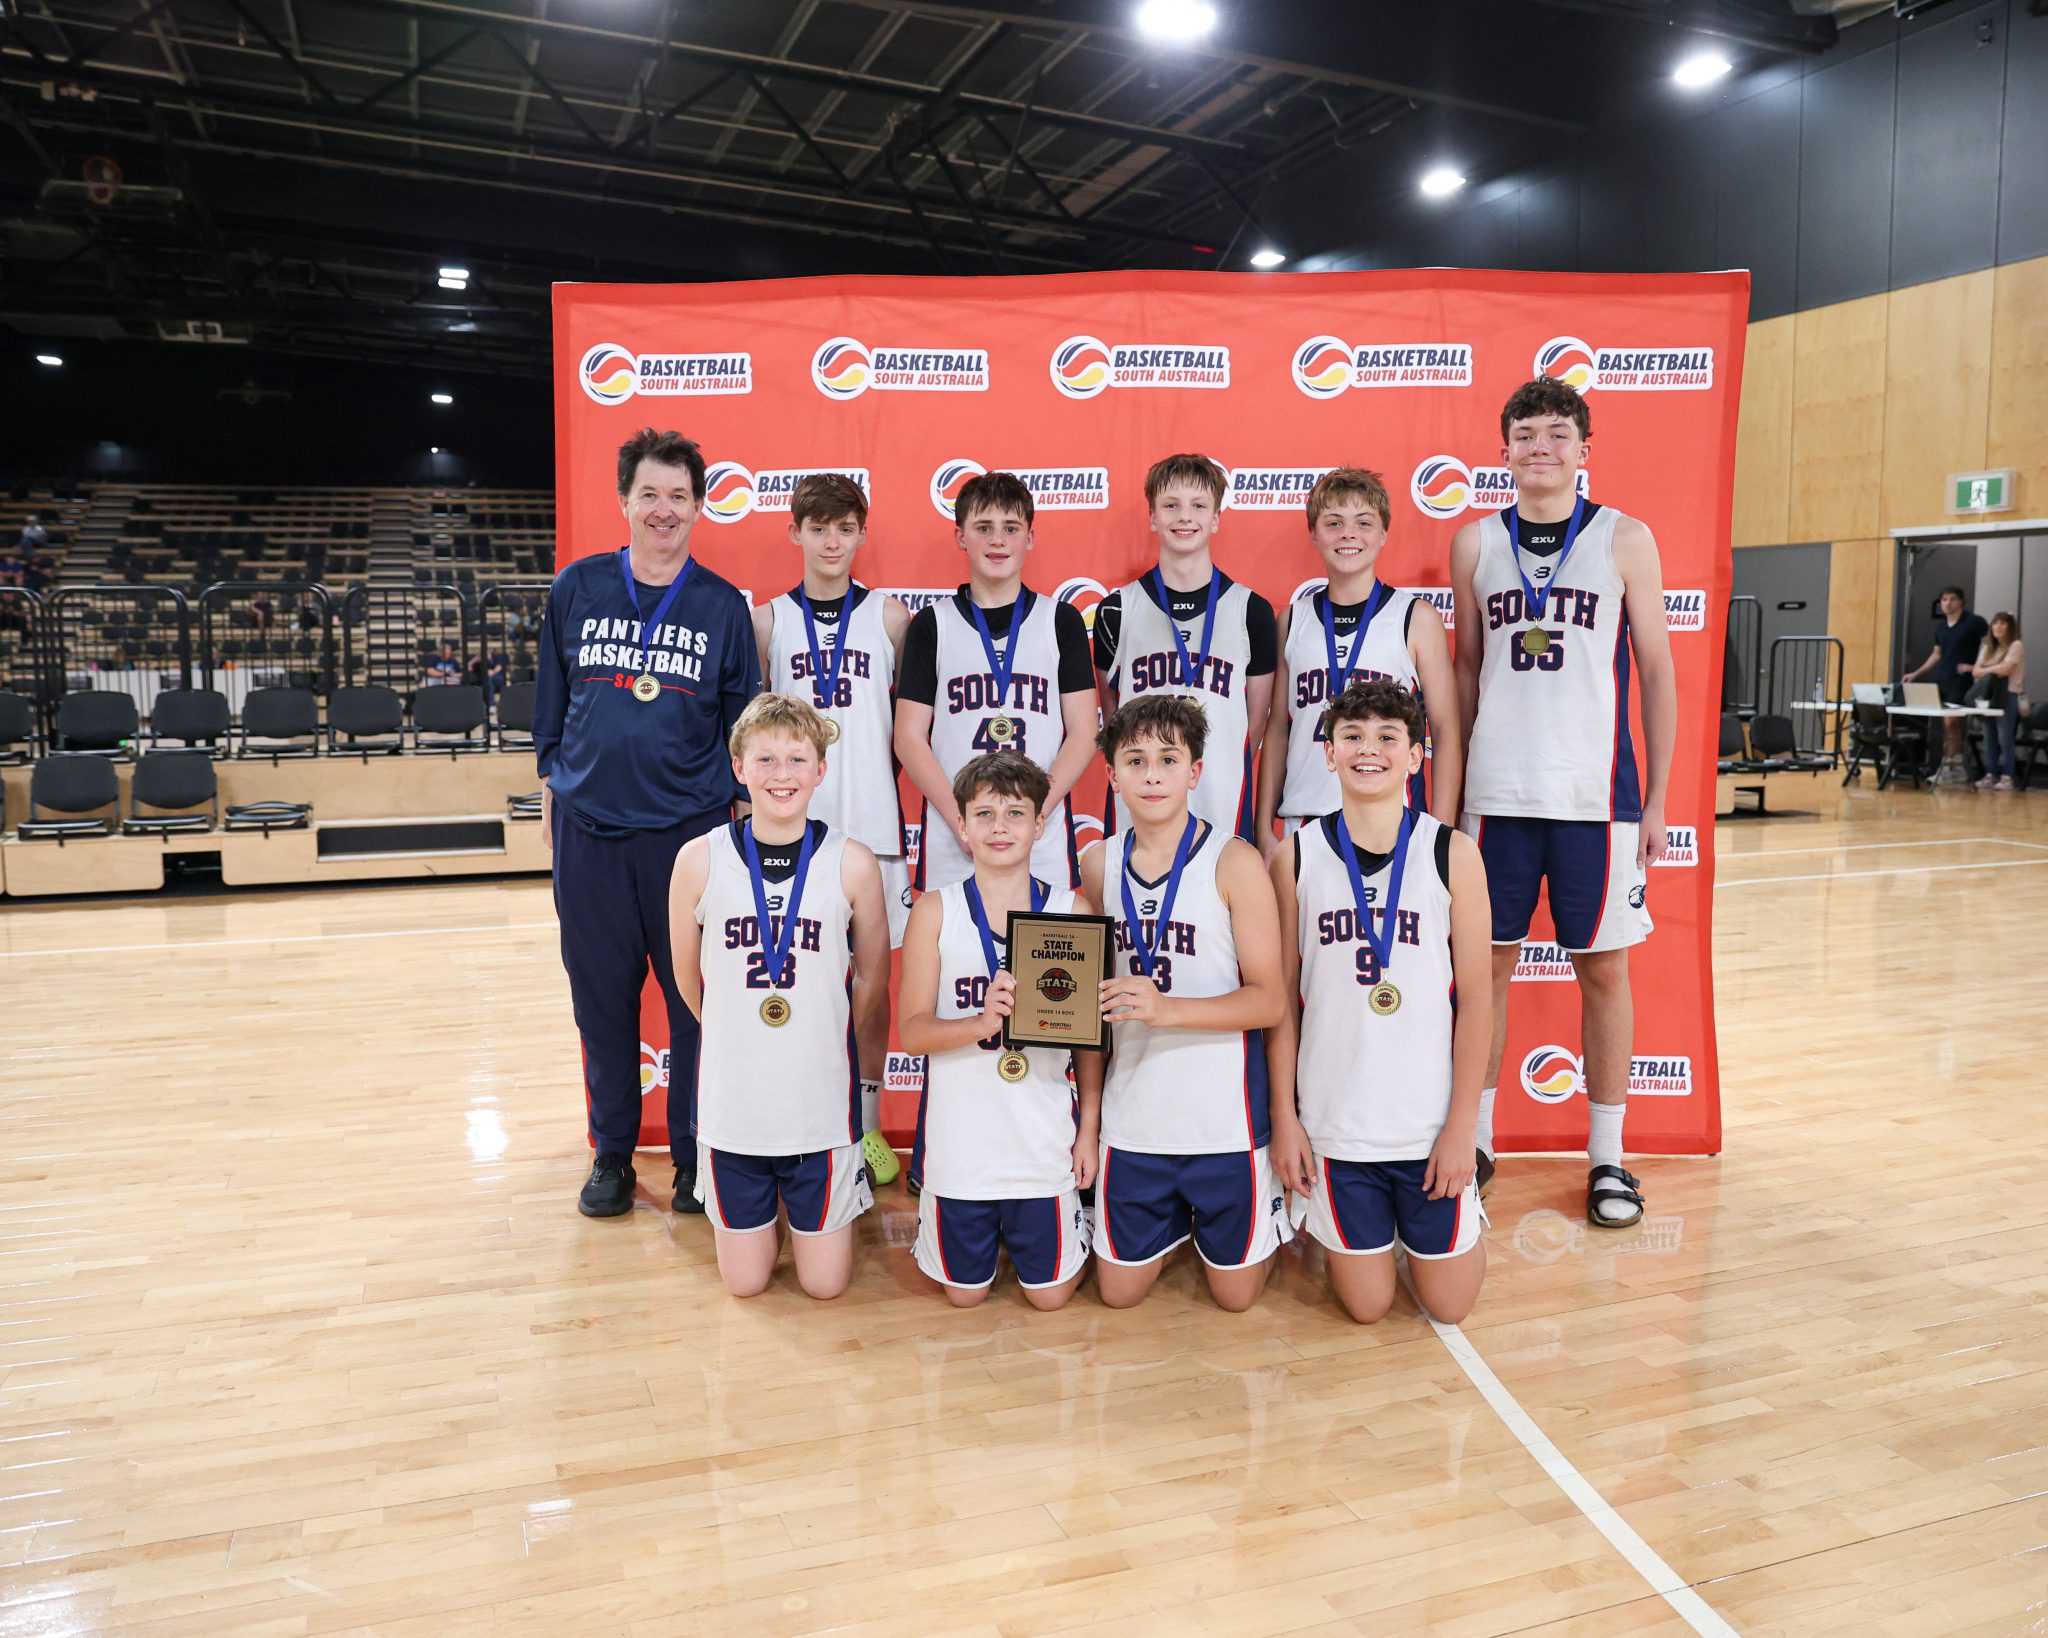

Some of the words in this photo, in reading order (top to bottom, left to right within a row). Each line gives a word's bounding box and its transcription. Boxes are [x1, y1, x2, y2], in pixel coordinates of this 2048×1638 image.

[874, 353, 983, 371] BASKETBALL
[1114, 350, 1224, 368] BASKETBALL
[1356, 349, 1467, 367] BASKETBALL
[1598, 353, 1708, 370] BASKETBALL
[640, 358, 747, 376] BASKETBALL
[874, 373, 914, 384] SOUTH
[918, 374, 984, 386] AUSTRALIA
[1114, 370, 1154, 382] SOUTH
[1158, 370, 1225, 382] AUSTRALIA
[1356, 370, 1396, 382] SOUTH
[1400, 369, 1467, 381] AUSTRALIA
[1597, 373, 1637, 385] SOUTH
[1641, 373, 1707, 385] AUSTRALIA
[640, 378, 678, 390] SOUTH
[683, 377, 747, 389] AUSTRALIA
[1037, 492, 1103, 505] AUSTRALIA
[1234, 493, 1273, 505] SOUTH
[1474, 491, 1514, 504] SOUTH
[1531, 536, 1556, 544] 2XU
[1487, 587, 1599, 631] SOUTH
[1334, 616, 1356, 624] 2XU
[579, 643, 702, 683] BASKETBALL
[790, 648, 871, 681] SOUTH
[1131, 650, 1234, 699] SOUTH
[947, 672, 1049, 716] SOUTH
[763, 858, 791, 867] 2XU
[1114, 918, 1196, 957] SOUTH
[1043, 940, 1073, 950] STATE
[1031, 949, 1085, 961] CHAMPION
[1355, 946, 1382, 985] 9
[1037, 978, 1076, 991] STATE
